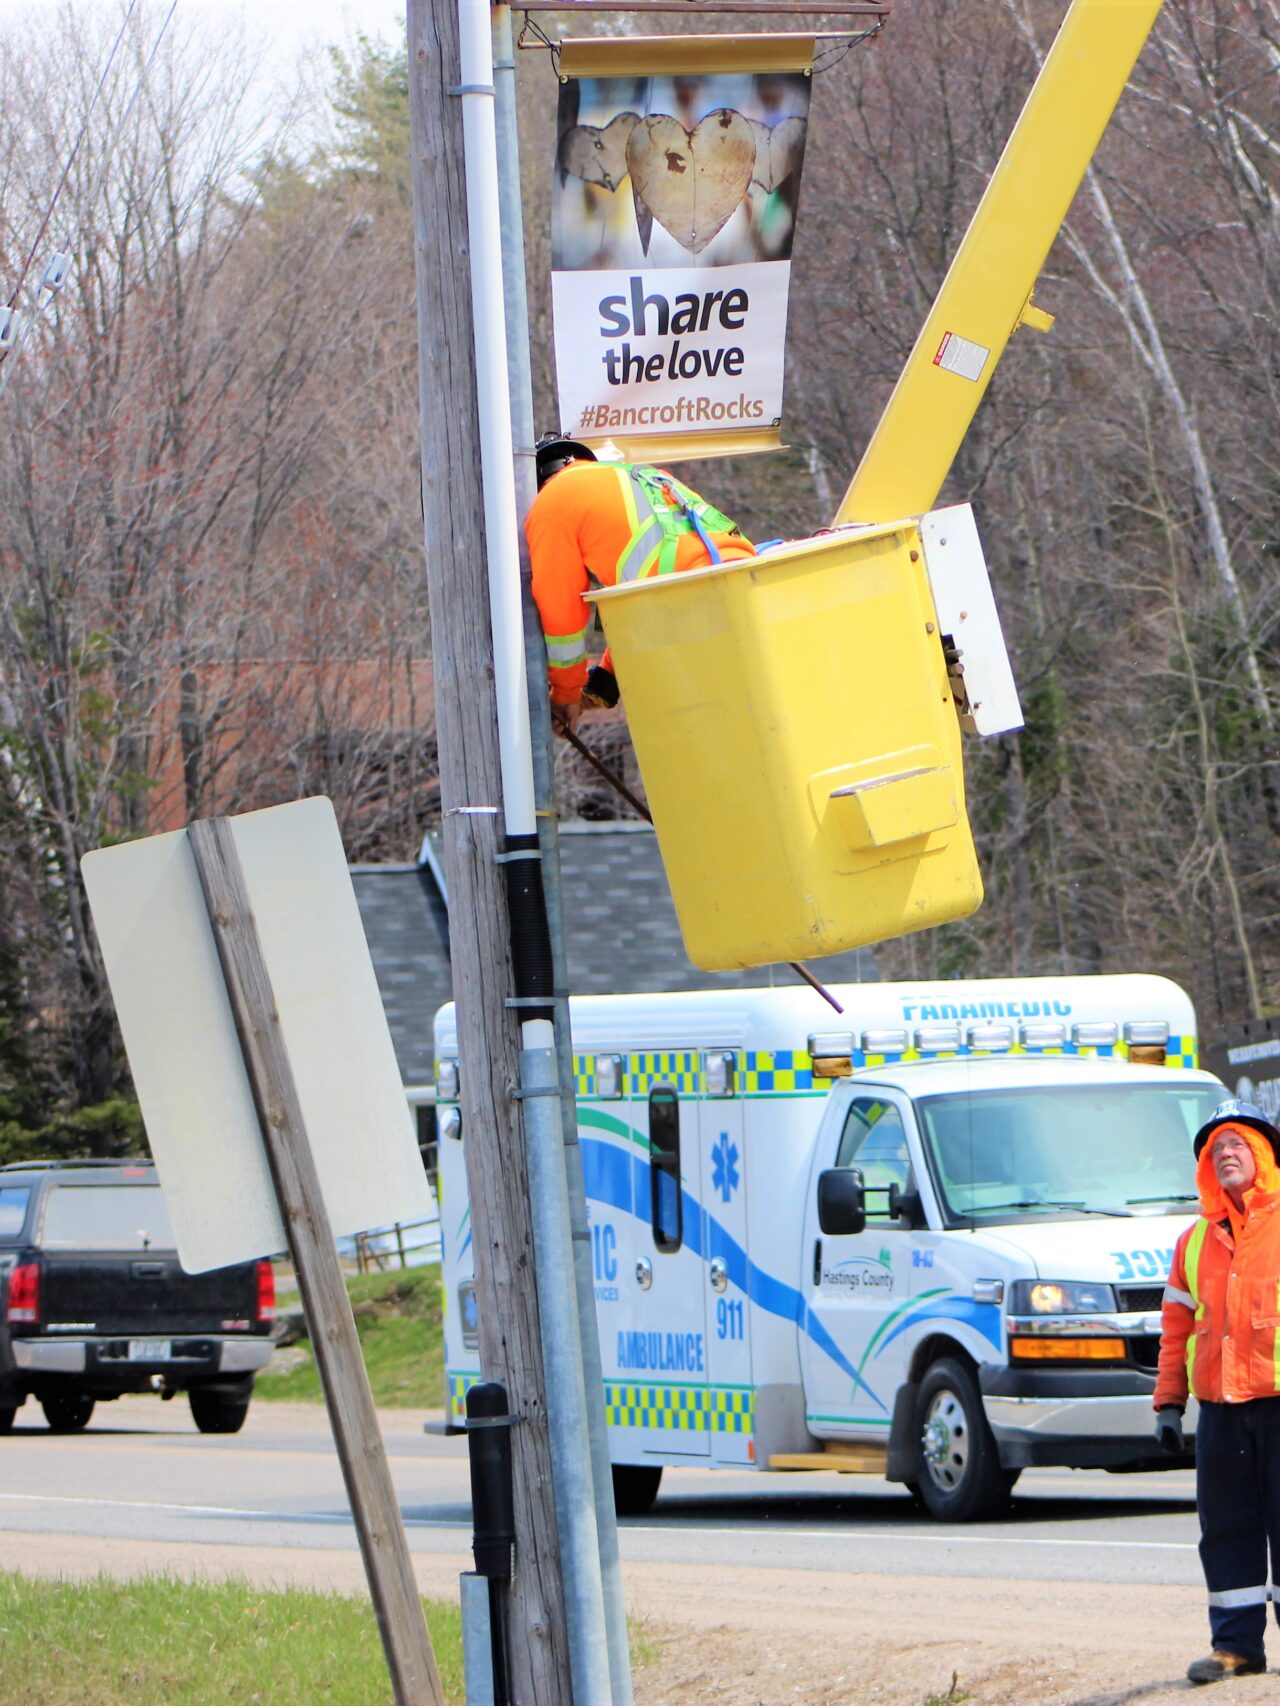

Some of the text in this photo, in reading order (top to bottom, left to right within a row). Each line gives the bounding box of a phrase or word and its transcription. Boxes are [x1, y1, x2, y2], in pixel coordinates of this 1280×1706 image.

[599, 276, 749, 337] share
[602, 340, 745, 385] the love
[580, 393, 764, 428] #BancroftRocks
[901, 990, 1072, 1021] PARAMEDIC
[823, 1269, 895, 1292] Hastings County
[717, 1297, 743, 1340] 911
[617, 1331, 704, 1372] AMBULANCE
